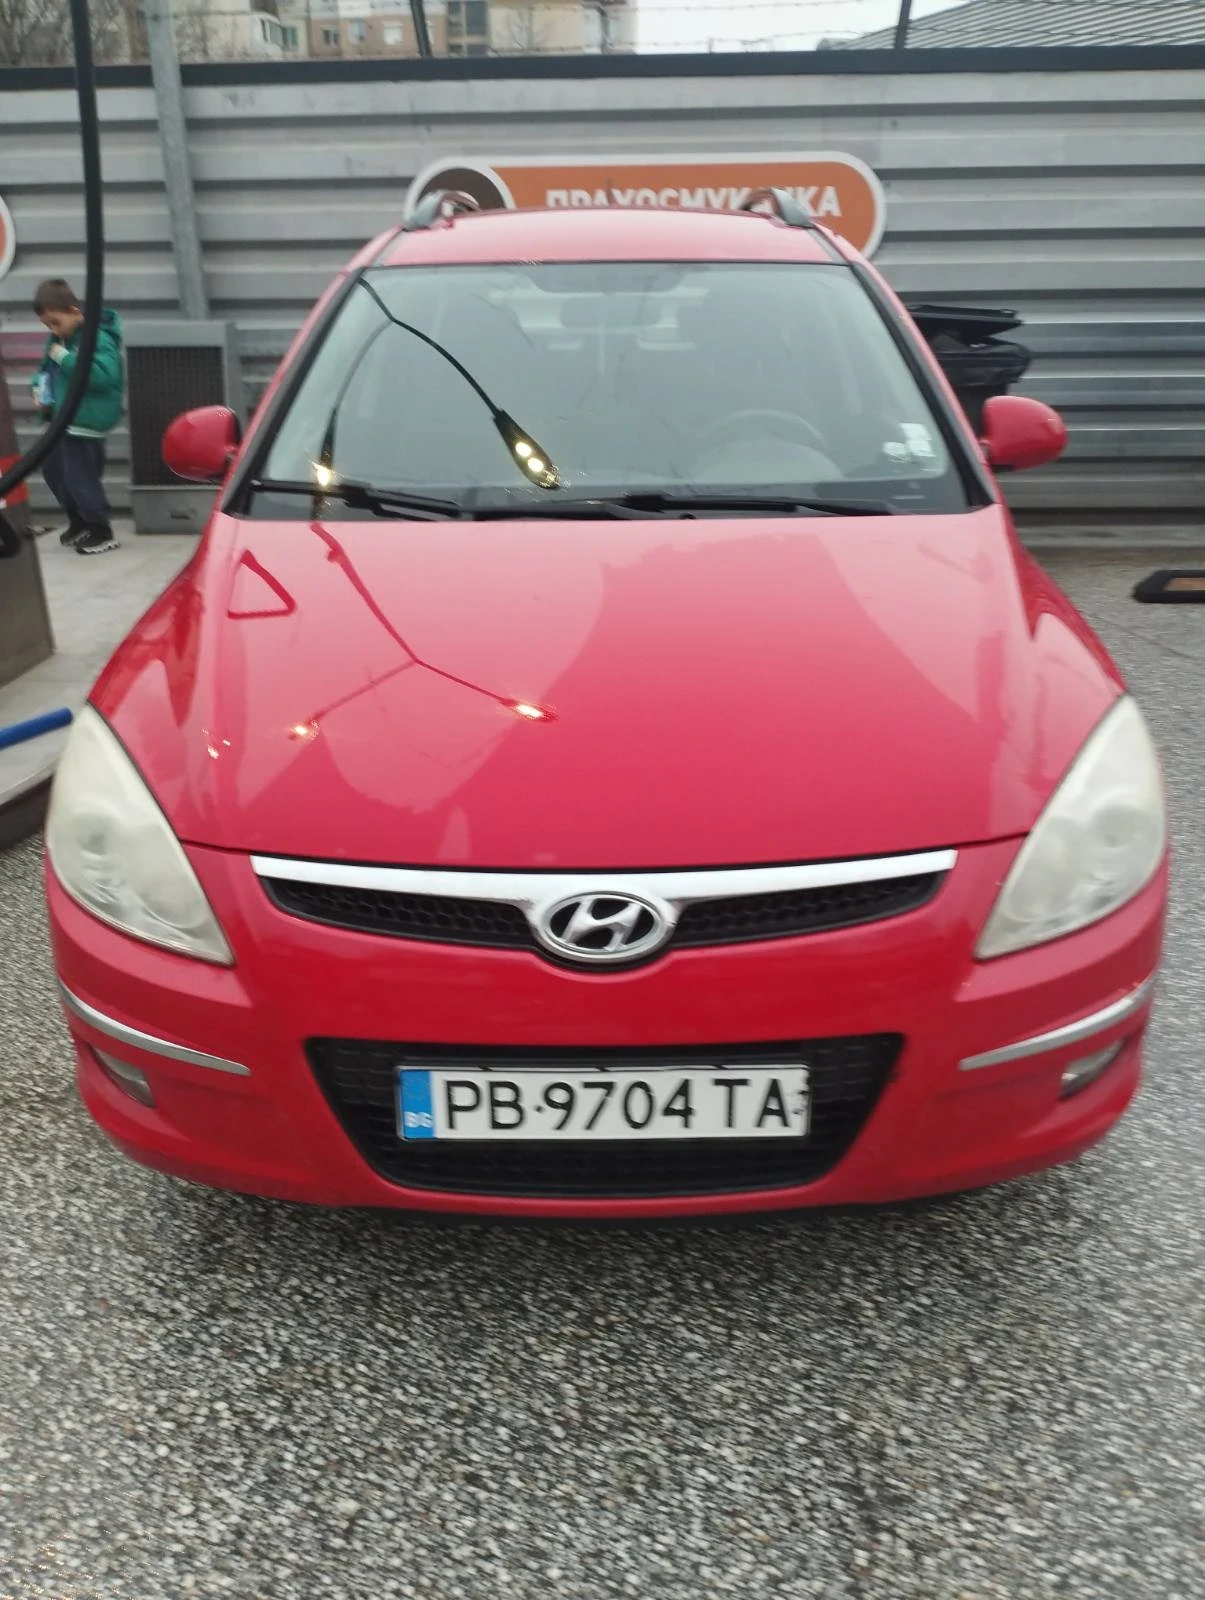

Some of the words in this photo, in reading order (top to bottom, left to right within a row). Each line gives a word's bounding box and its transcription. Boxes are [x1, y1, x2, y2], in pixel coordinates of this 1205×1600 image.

[443, 1080, 525, 1130] PB
[543, 1079, 695, 1130] 9704
[712, 1078, 790, 1129] TA
